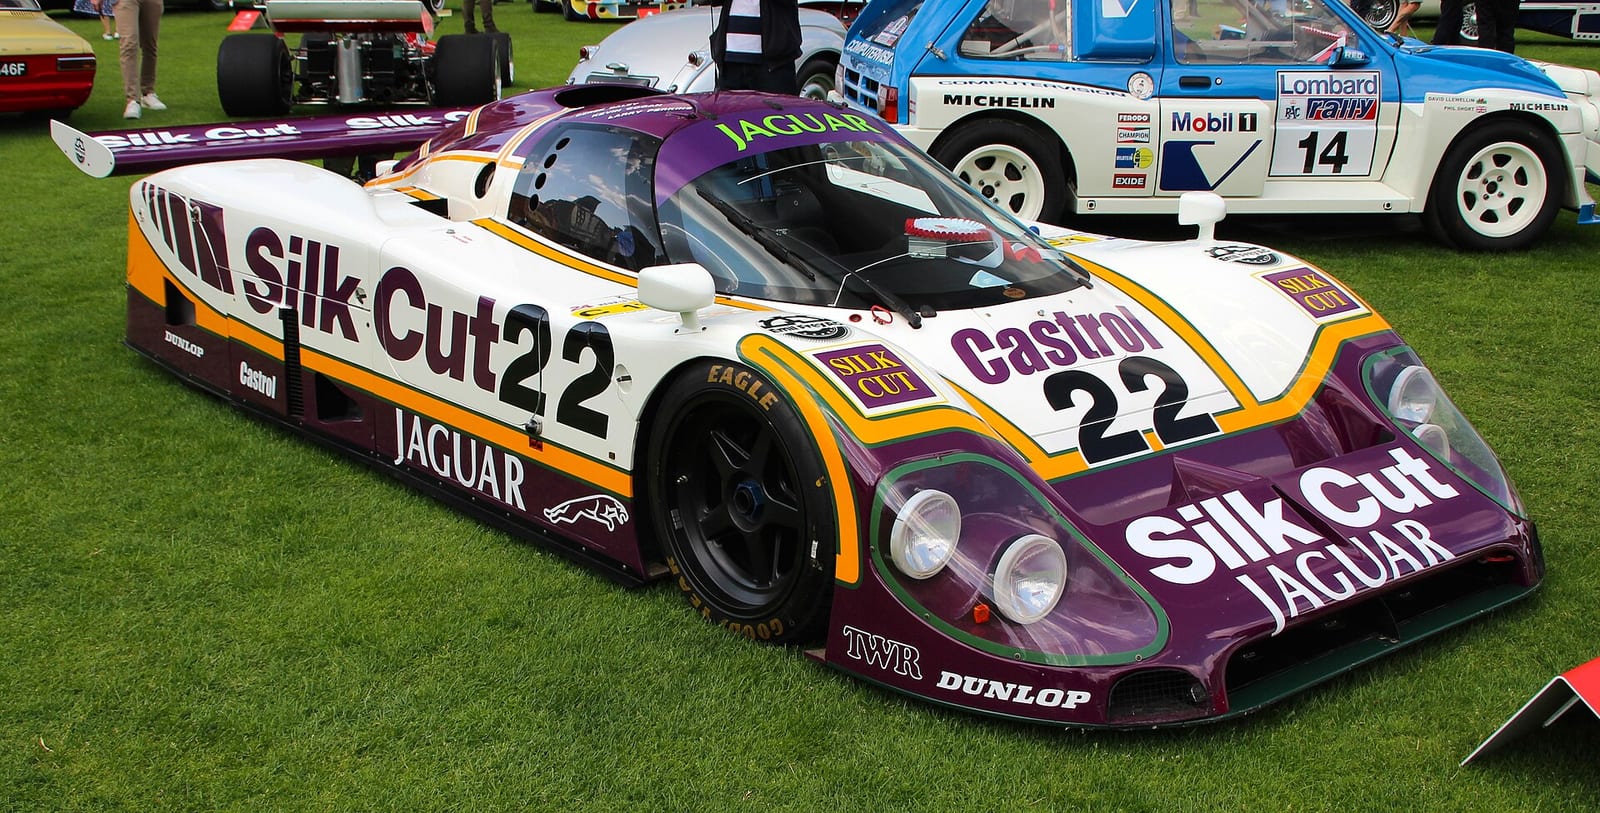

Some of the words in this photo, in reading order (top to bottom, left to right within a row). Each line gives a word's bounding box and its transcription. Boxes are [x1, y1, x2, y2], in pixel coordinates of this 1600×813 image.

[938, 79, 1127, 98] COMPUTERVISION
[1280, 74, 1377, 95] Lombard
[943, 94, 1055, 109] MICHELIN
[1307, 98, 1374, 120] rally
[1509, 102, 1569, 112] MICHELIN
[345, 113, 442, 130] Silk
[1118, 114, 1149, 122] FERODO
[1171, 112, 1233, 133] Mobil
[93, 129, 199, 149] Silk
[195, 123, 302, 142] Cut
[714, 113, 883, 152] JAGUAR
[1298, 131, 1349, 174] 14
[1115, 177, 1145, 185] EXIDE
[1278, 272, 1329, 294] SILK
[243, 226, 362, 343] Silk
[373, 266, 500, 394] Cut
[1303, 290, 1348, 312] CUT
[164, 330, 204, 358] DUNLOP
[950, 305, 1164, 385] Castrol
[498, 303, 615, 440] 22
[829, 349, 903, 376] SILK
[239, 360, 277, 400] Castrol
[707, 364, 778, 411] EAGLE
[857, 371, 919, 399] CUT
[1043, 355, 1221, 465] 22
[394, 407, 527, 512] JAGUAR
[1125, 490, 1323, 585] Silk
[1298, 447, 1460, 528] Cut
[1236, 519, 1456, 638] JAGUAR
[843, 625, 923, 680] TWR
[936, 671, 1092, 710] DUNLOP
